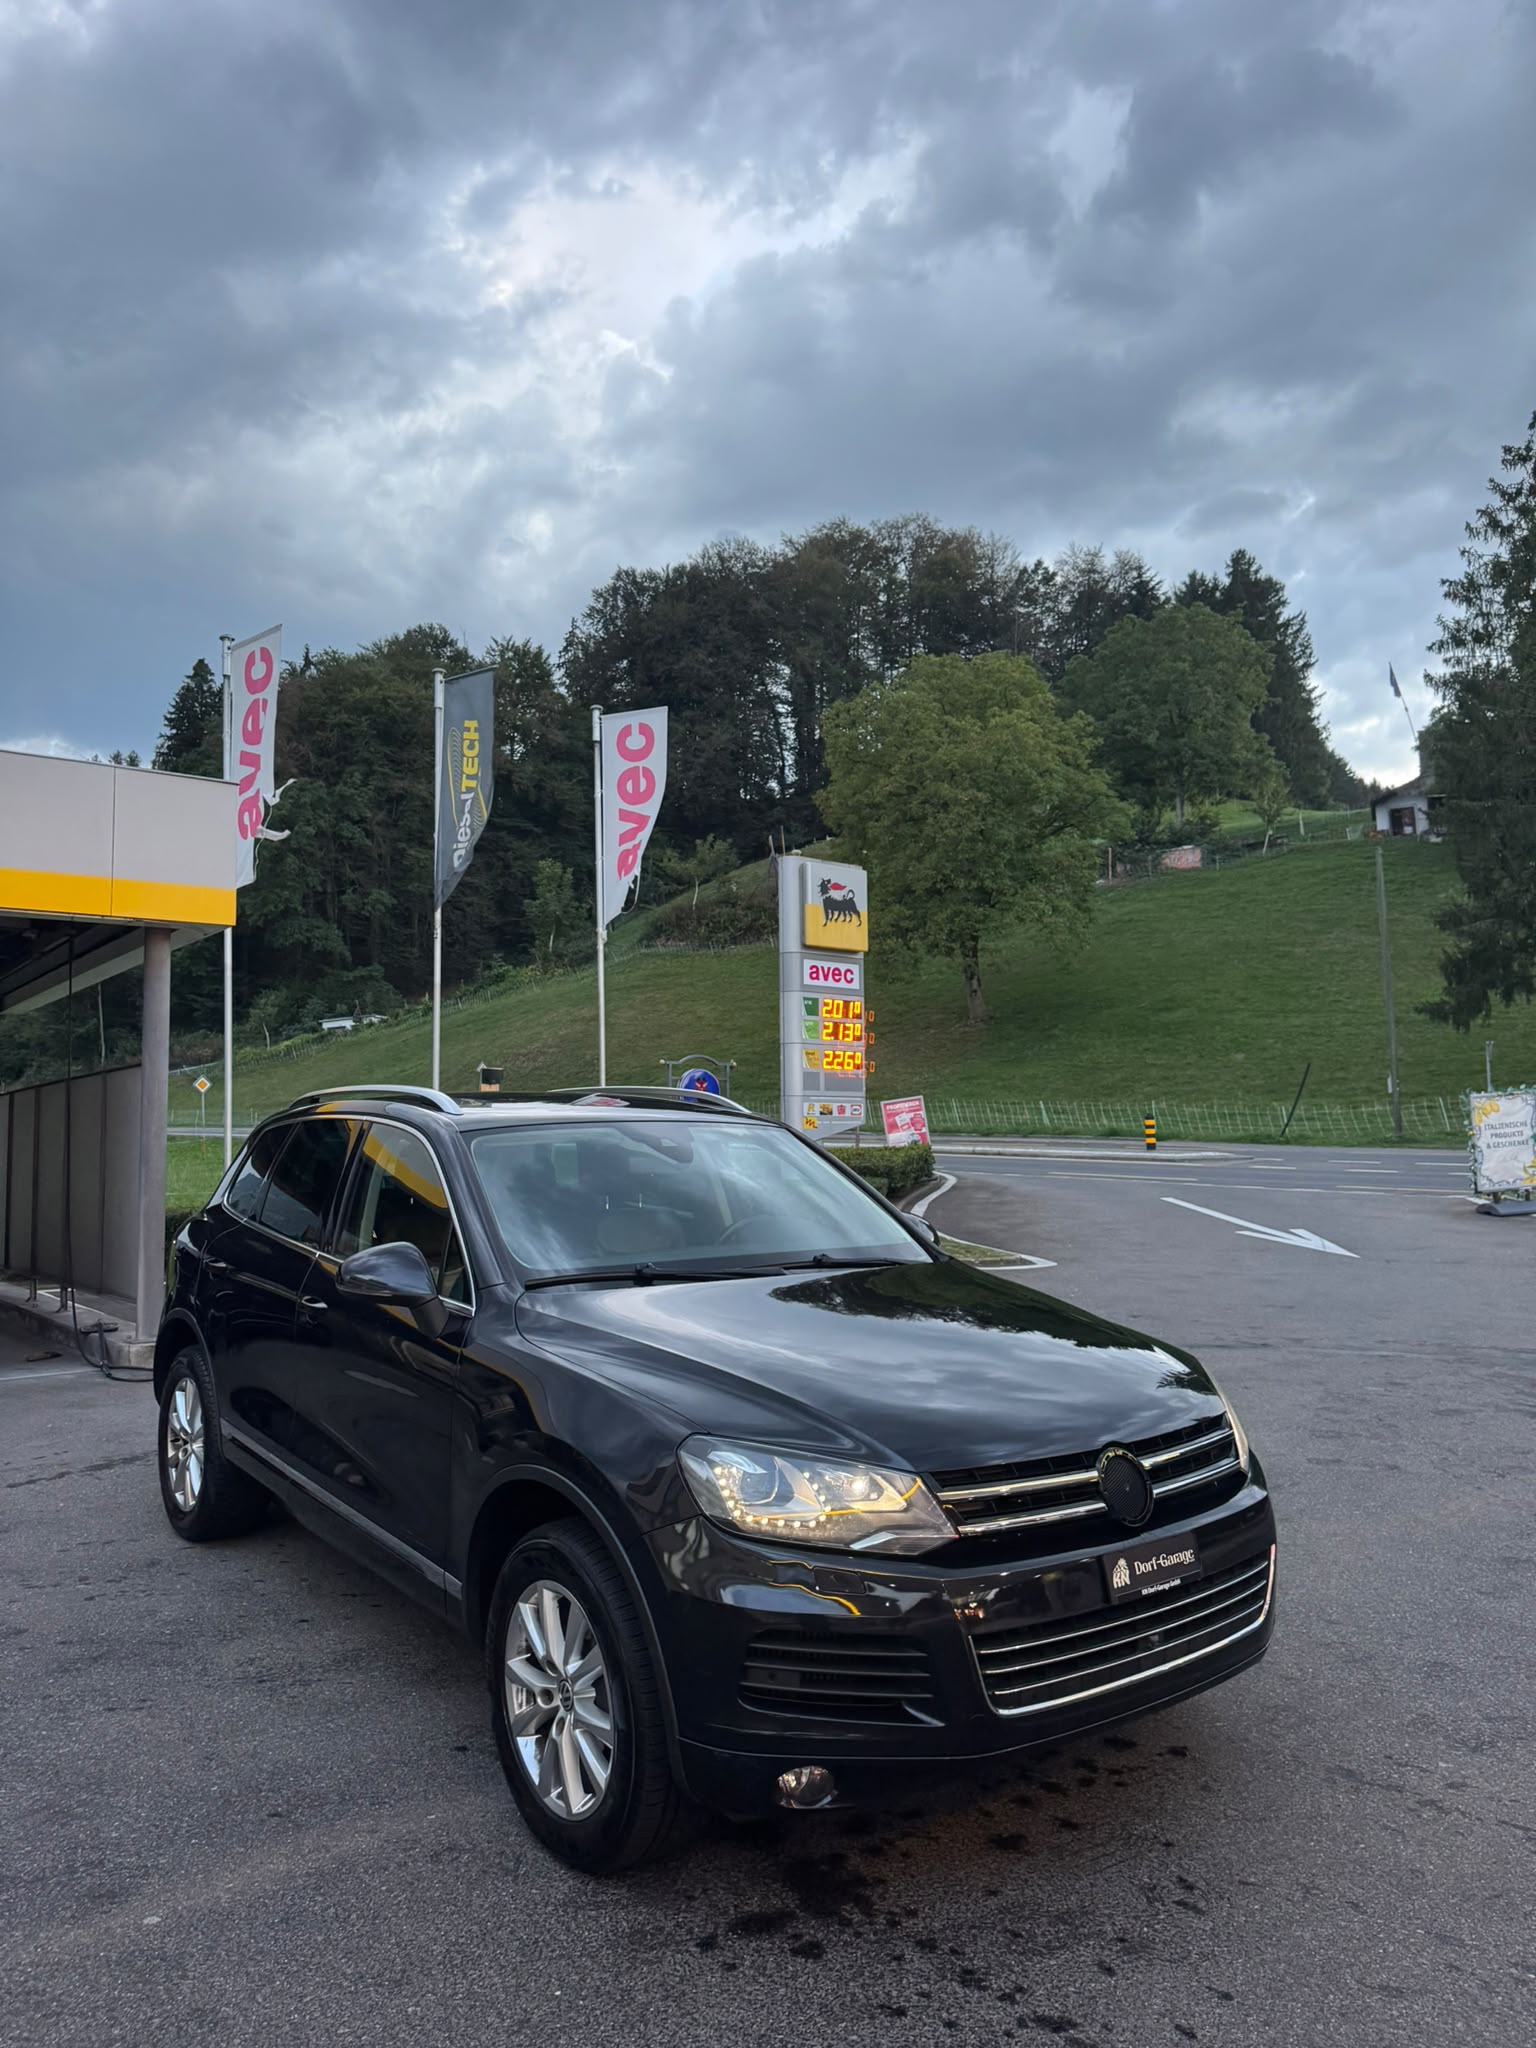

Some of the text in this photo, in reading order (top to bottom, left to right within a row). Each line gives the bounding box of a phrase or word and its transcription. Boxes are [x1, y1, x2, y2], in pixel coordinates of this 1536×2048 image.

[237, 646, 274, 840] avec
[616, 722, 656, 880] avec
[808, 964, 854, 985] avec
[1484, 1121, 1528, 1131] ITALIENISCHE
[1490, 1130, 1524, 1139] PRODUKTE
[1492, 1139, 1529, 1149] GESCHENKE
[1134, 1549, 1195, 1575] Dorf-Garage
